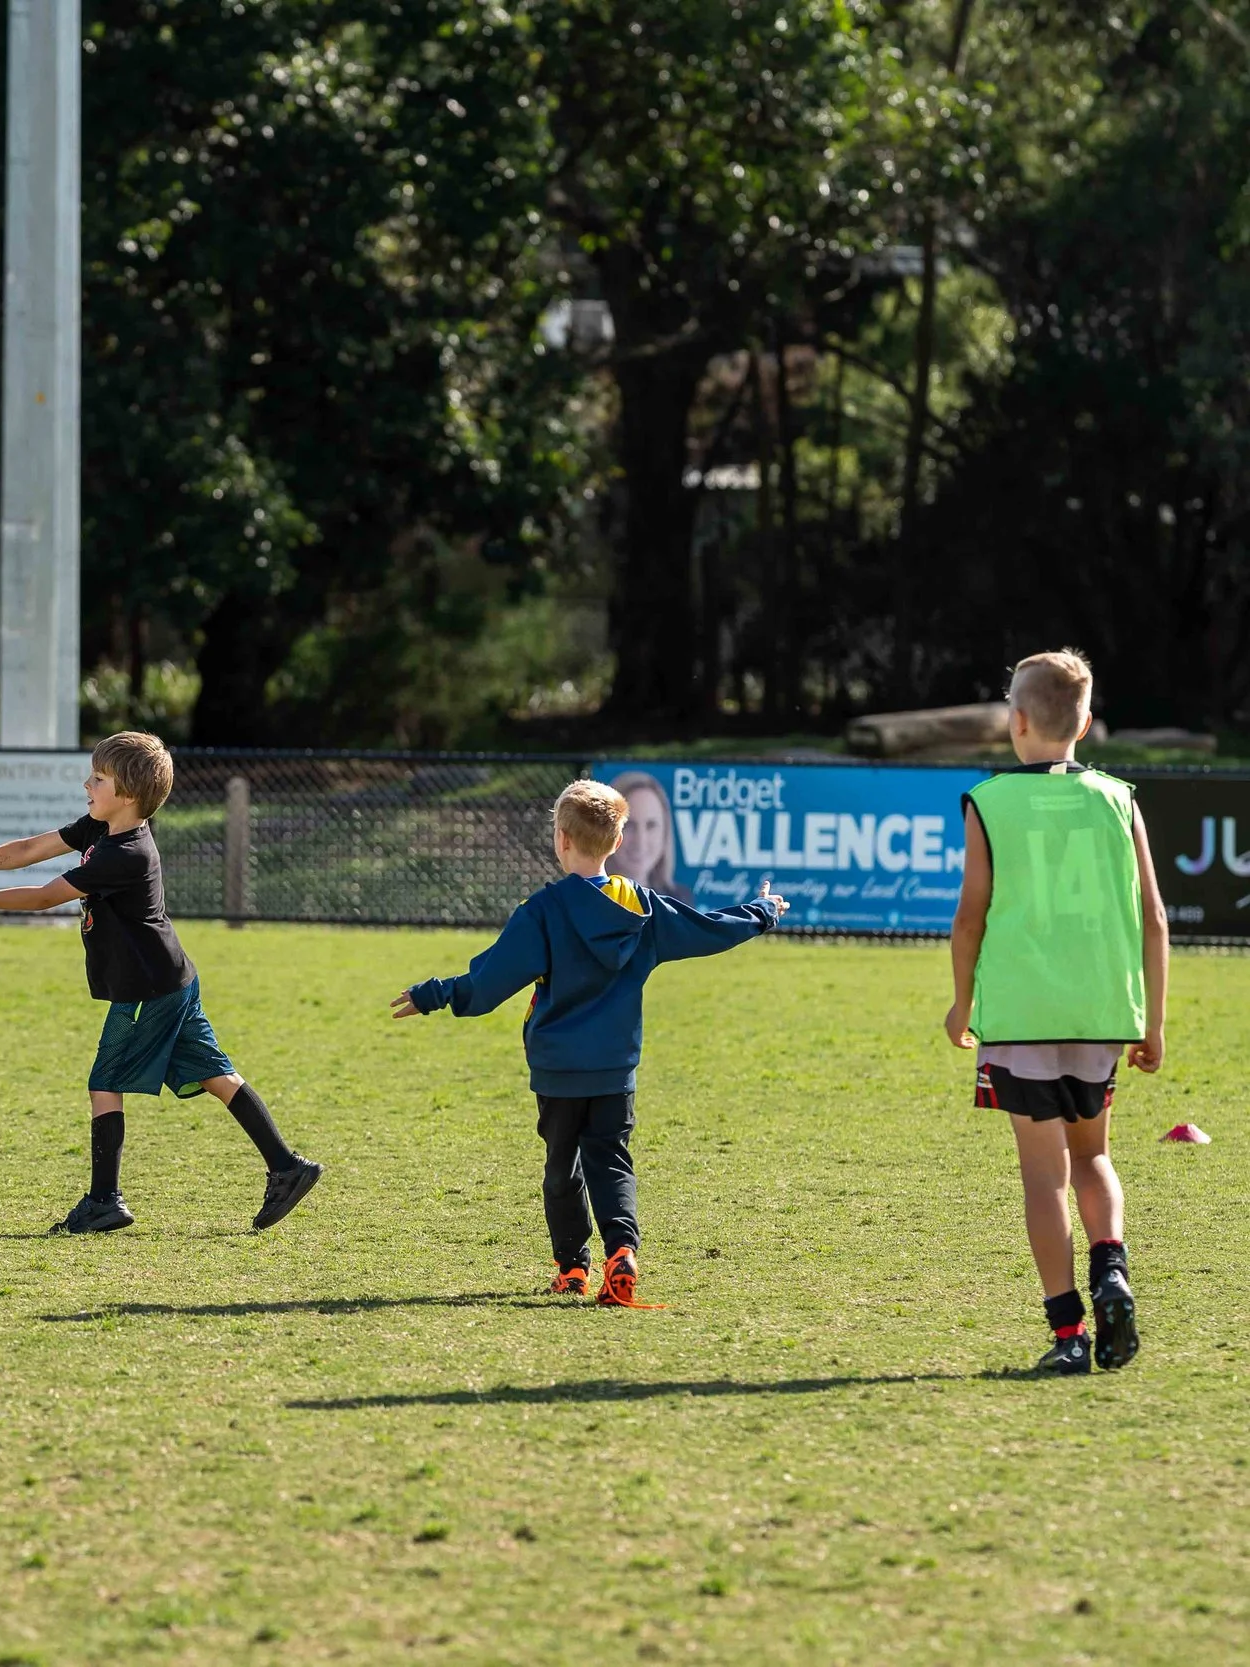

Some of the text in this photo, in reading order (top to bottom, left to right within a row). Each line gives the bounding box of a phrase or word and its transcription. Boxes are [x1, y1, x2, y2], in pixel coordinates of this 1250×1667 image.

[59, 763, 88, 780] CL
[674, 768, 785, 815] Bridget
[676, 809, 965, 873] VALLENCE M
